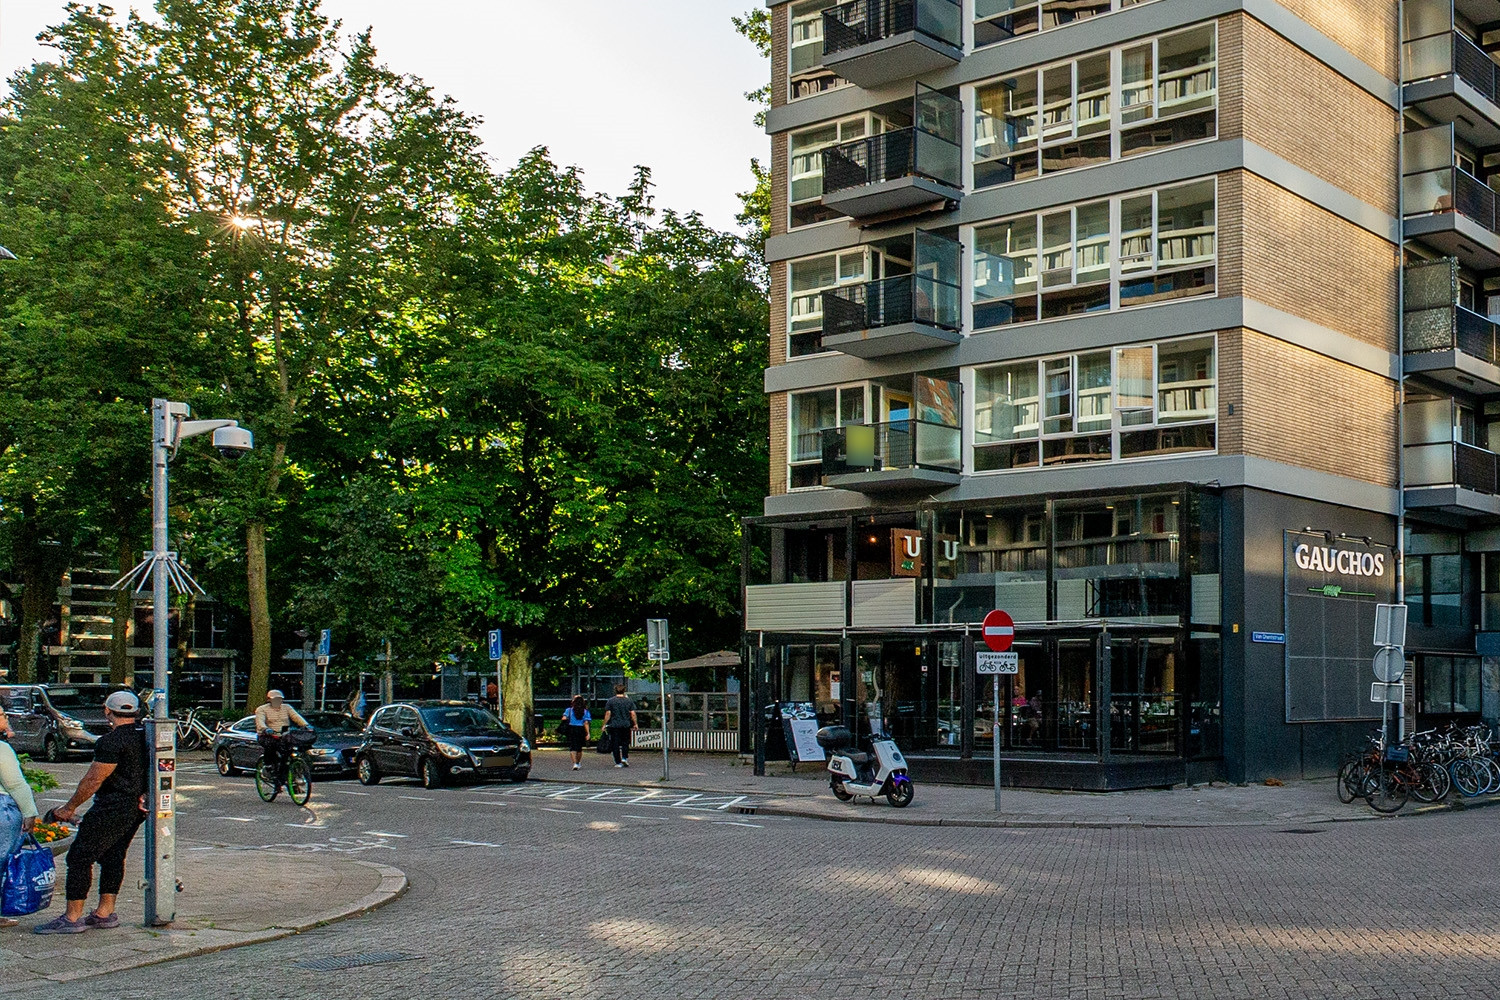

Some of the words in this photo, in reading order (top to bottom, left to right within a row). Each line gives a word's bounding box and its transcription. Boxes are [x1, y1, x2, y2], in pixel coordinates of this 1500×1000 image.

[1295, 543, 1385, 577] GAUCHOS
[490, 632, 498, 648] P
[637, 733, 661, 743] GAUCHOS
